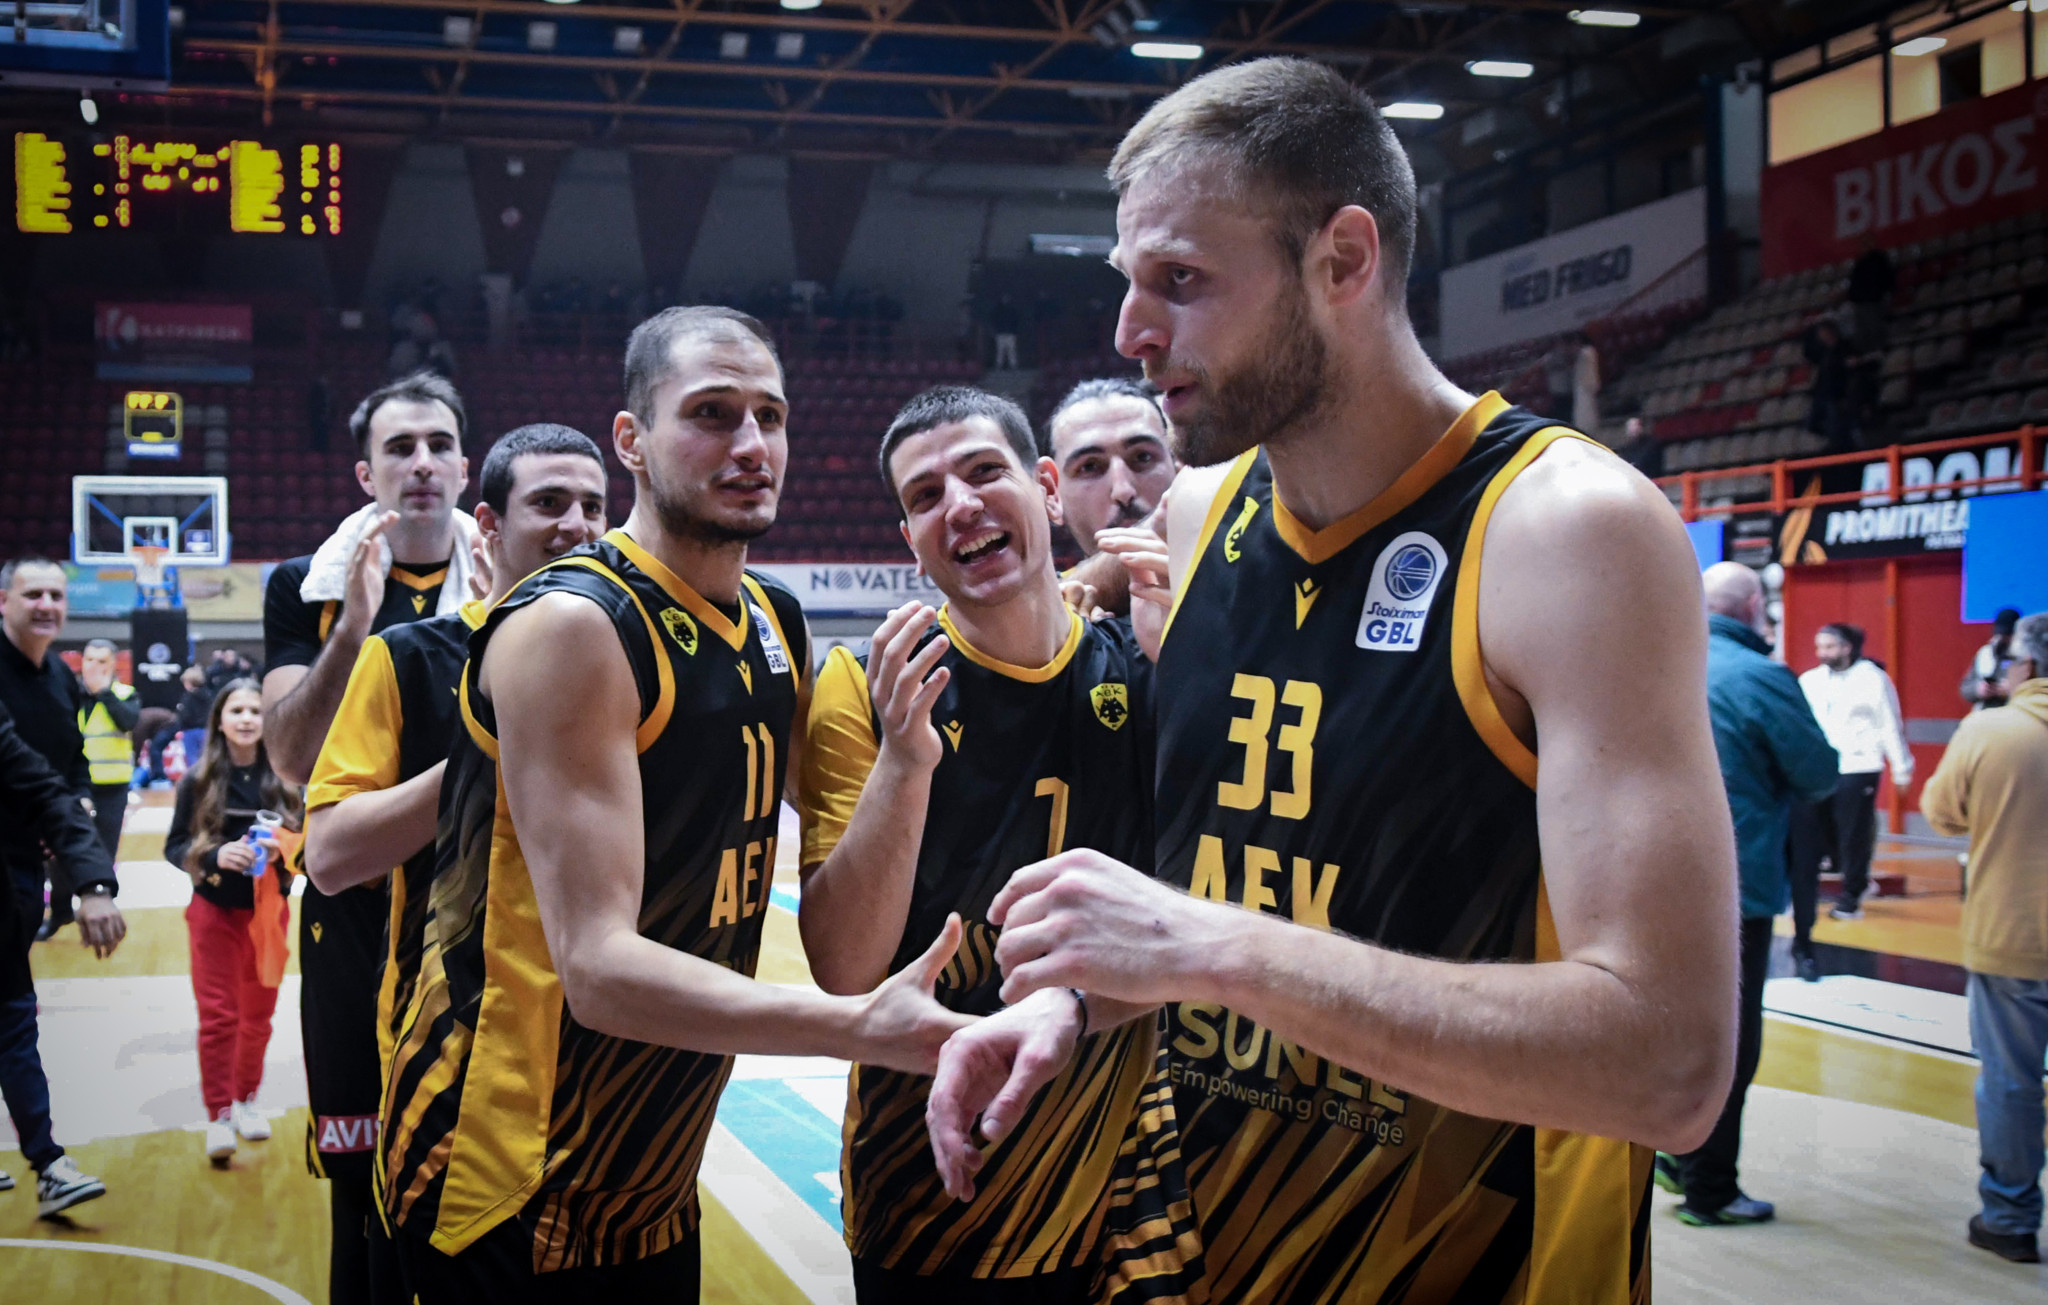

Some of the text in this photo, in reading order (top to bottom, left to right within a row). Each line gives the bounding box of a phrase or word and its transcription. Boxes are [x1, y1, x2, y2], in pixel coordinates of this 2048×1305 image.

[1366, 619, 1414, 644] GBL
[742, 722, 775, 822] 11
[1217, 672, 1322, 820] 33
[1188, 834, 1341, 933] AEK
[1170, 1062, 1404, 1144] Empowering Change
